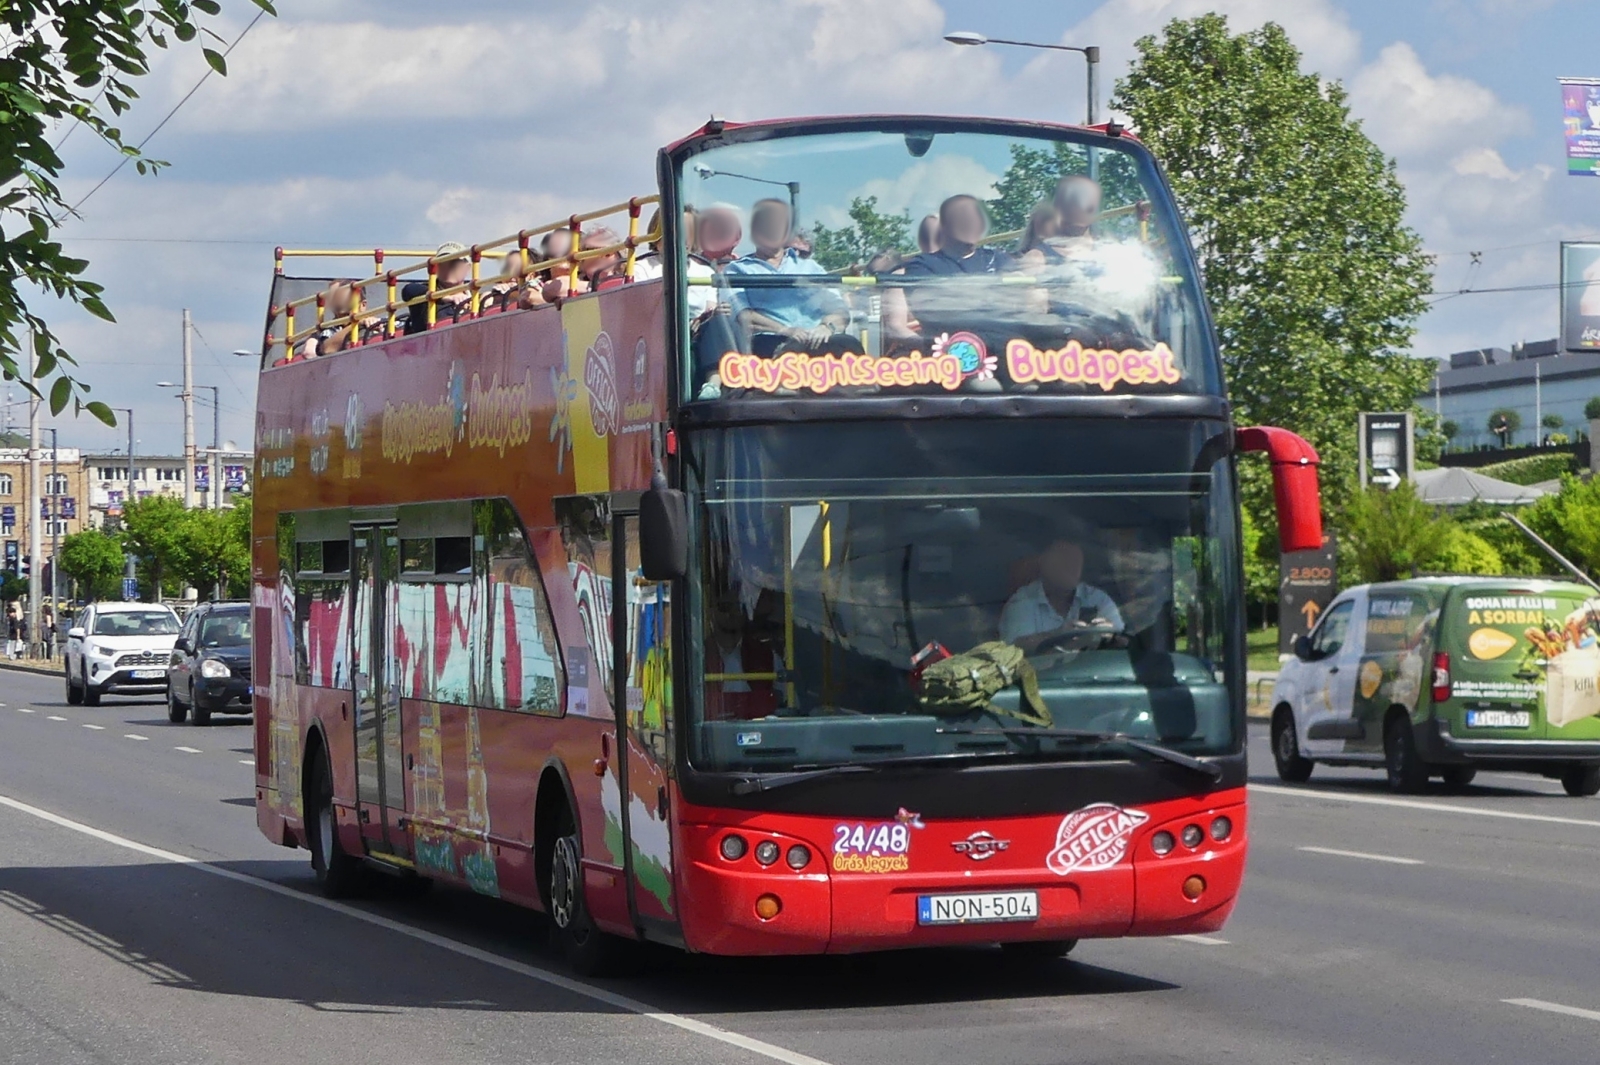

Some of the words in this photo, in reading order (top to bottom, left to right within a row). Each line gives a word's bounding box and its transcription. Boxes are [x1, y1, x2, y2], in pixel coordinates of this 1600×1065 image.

[719, 351, 962, 393] CitySightseeing
[1006, 339, 1181, 392] Budapest
[587, 357, 617, 428] OFFICIAL
[469, 367, 532, 458] Budapest
[1466, 597, 1501, 609] SOHA
[1502, 597, 1517, 609] NE
[1468, 610, 1481, 624] A
[1483, 610, 1543, 625] SORBA!
[1574, 676, 1594, 692] kifli
[834, 823, 908, 853] 24/48
[1058, 813, 1142, 868] OFFICIAL
[1089, 837, 1128, 866] TOUR
[833, 852, 863, 871] Órás
[936, 895, 1033, 919] NON-504
